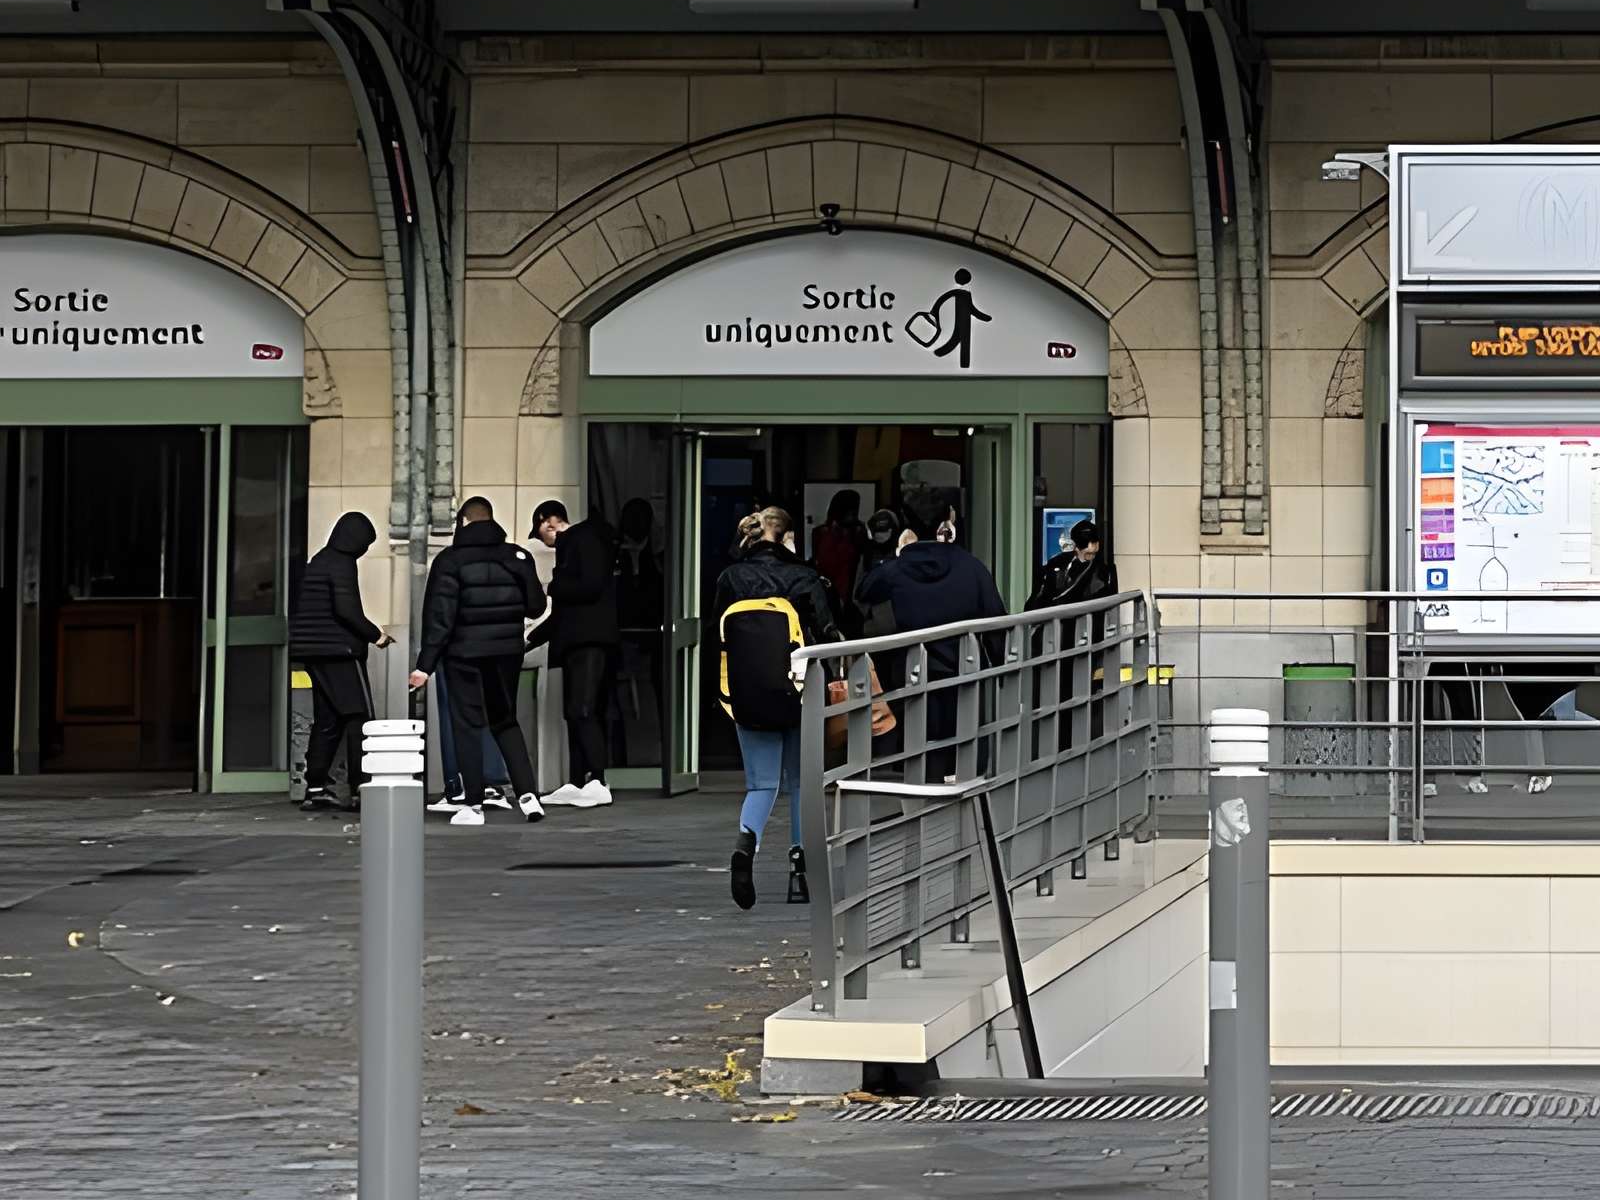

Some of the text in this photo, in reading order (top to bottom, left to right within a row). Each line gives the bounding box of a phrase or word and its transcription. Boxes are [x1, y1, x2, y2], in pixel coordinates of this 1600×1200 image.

[13, 287, 109, 312] Sortie
[801, 284, 896, 310] Sortie
[12, 320, 205, 352] uniquement
[705, 317, 895, 348] uniquement
